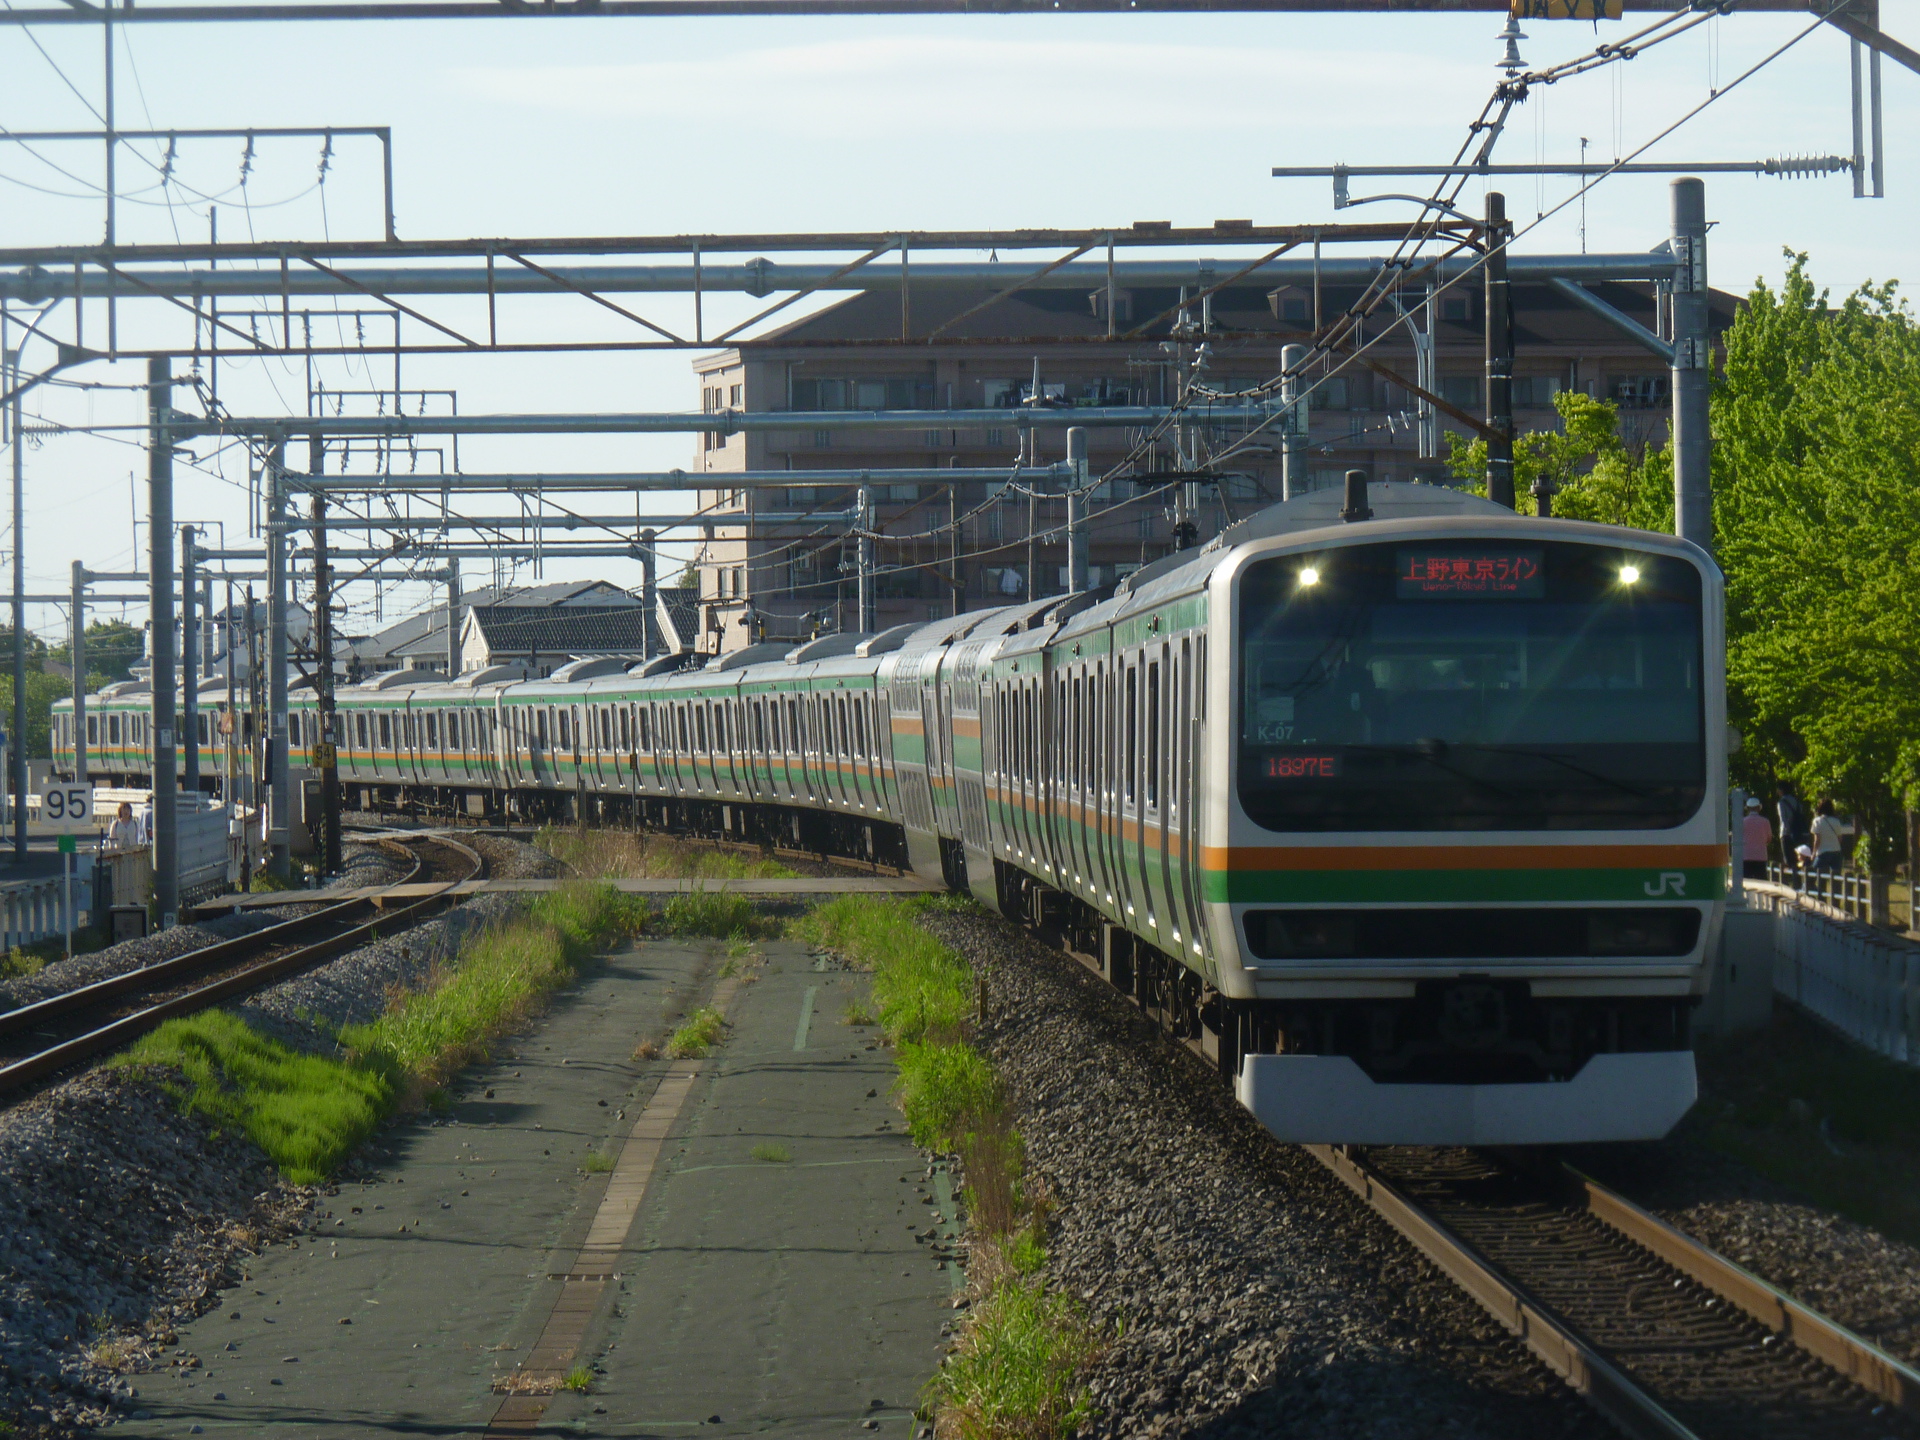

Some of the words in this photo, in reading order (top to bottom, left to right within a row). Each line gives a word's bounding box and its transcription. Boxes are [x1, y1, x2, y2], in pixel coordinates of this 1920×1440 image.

[1402, 556, 1538, 581] 上野東京ライン
[1492, 581, 1517, 591] Line
[1257, 726, 1294, 740] K-07
[315, 745, 331, 760] 54
[1269, 757, 1335, 777] 1897E
[46, 789, 87, 820] 95
[1643, 871, 1687, 897] JR
